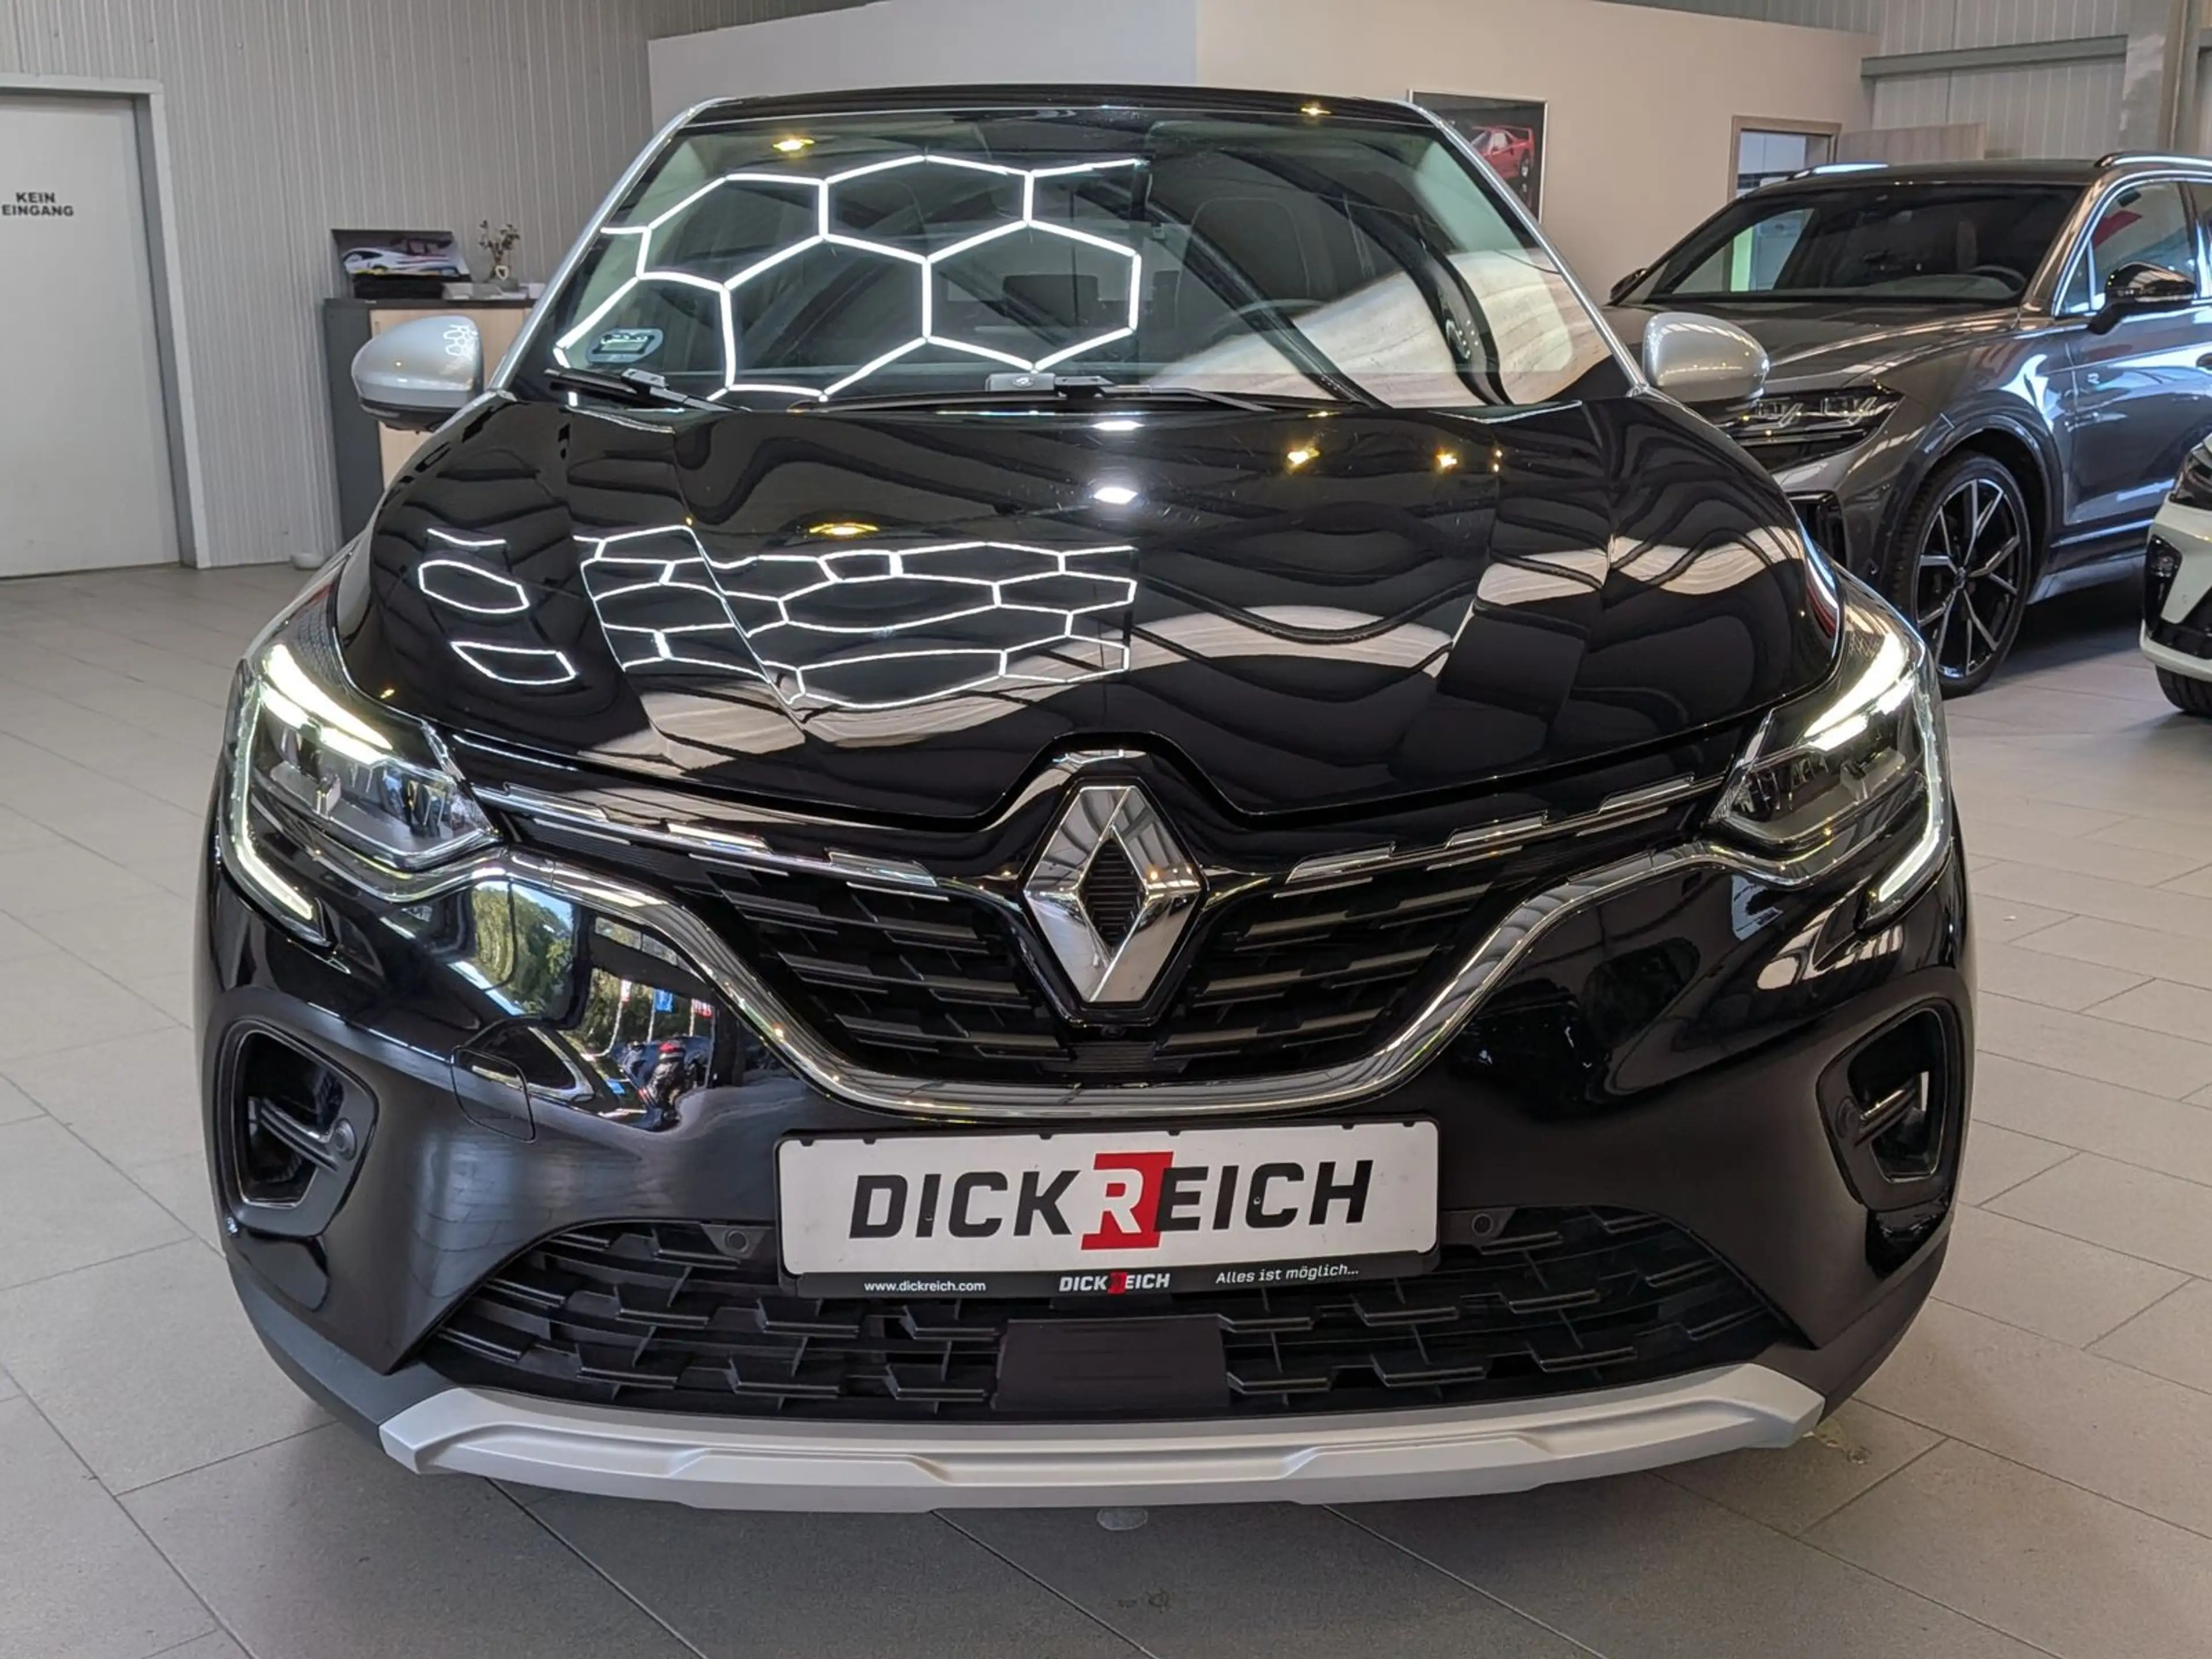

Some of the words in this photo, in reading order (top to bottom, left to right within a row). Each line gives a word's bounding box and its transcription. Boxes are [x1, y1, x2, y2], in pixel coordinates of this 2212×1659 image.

[16, 191, 56, 203] KEIN
[2, 204, 74, 217] EINGANG
[850, 1152, 1373, 1250] DICKREICH
[1215, 1272, 1255, 1283] Alles
[1258, 1268, 1282, 1281] ist
[1285, 1264, 1359, 1281] möglich...
[864, 1280, 986, 1291] www.dickreich.com
